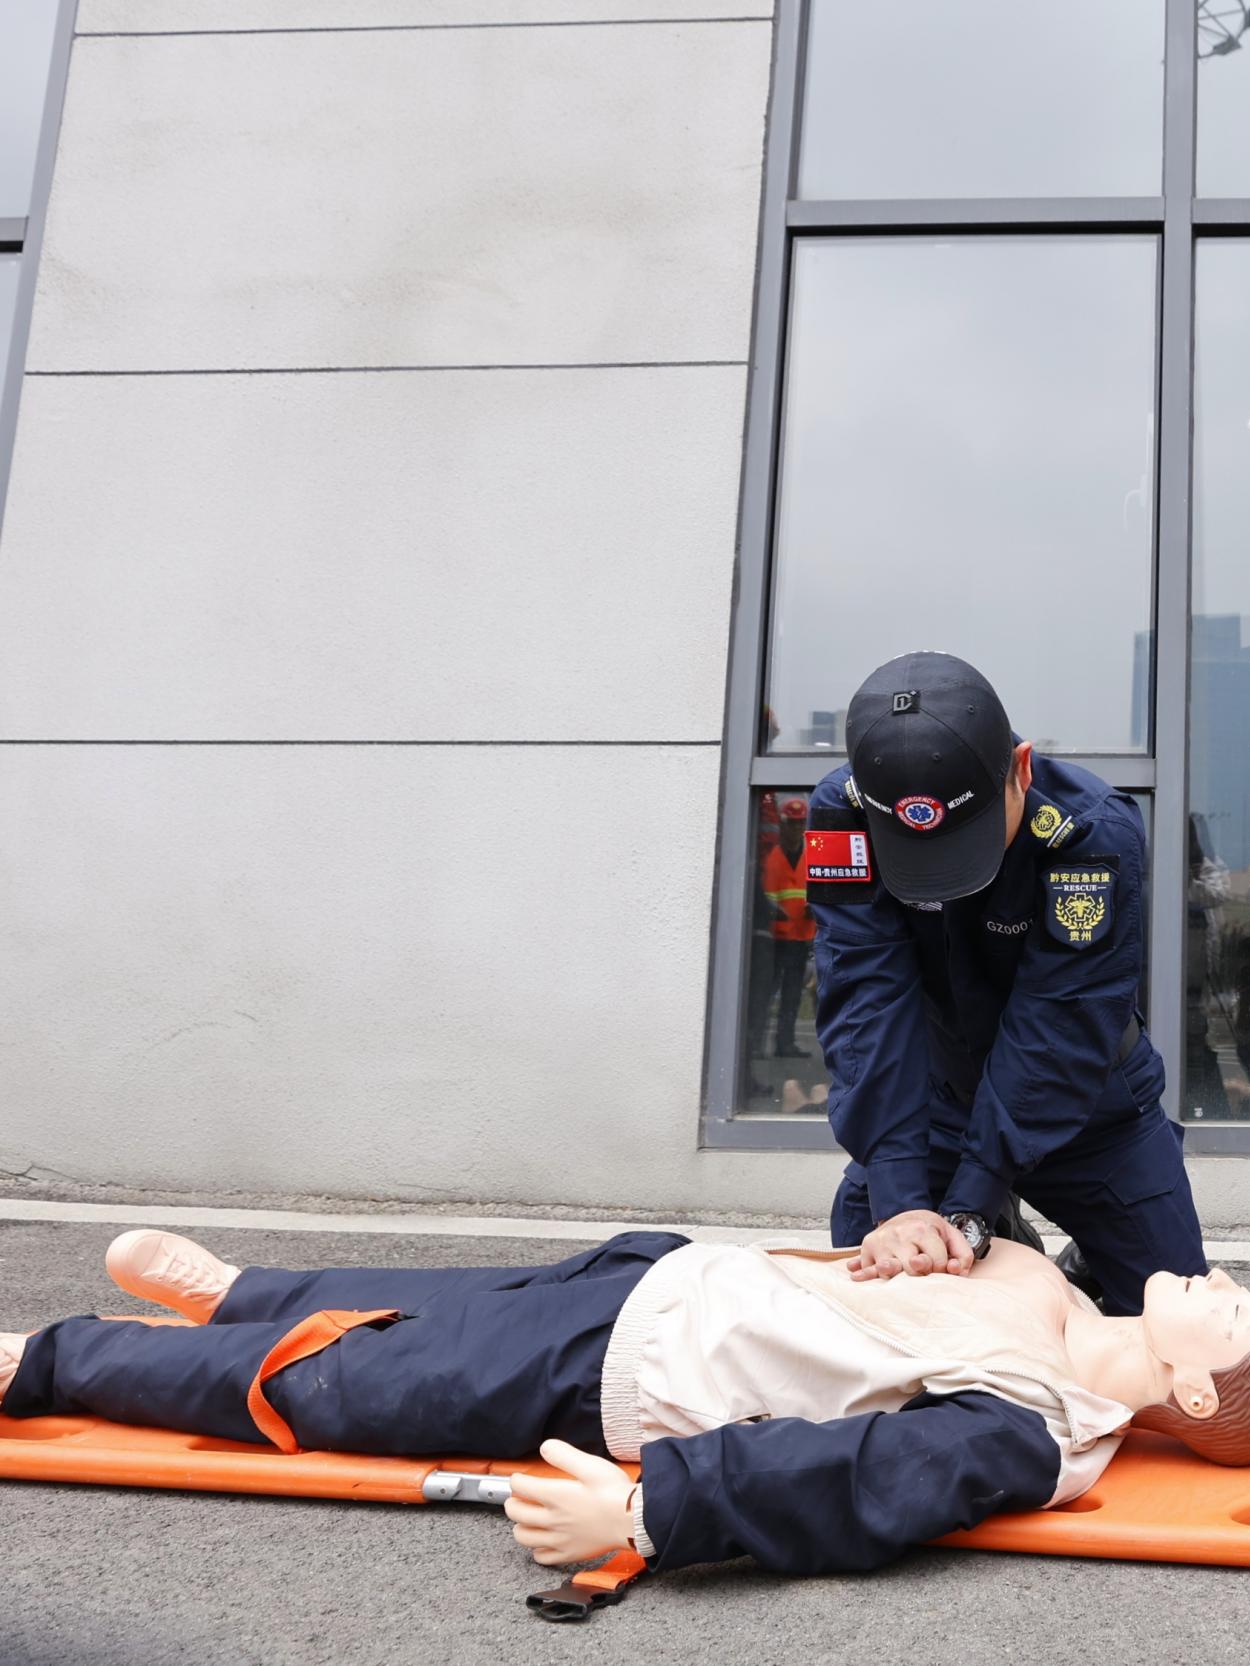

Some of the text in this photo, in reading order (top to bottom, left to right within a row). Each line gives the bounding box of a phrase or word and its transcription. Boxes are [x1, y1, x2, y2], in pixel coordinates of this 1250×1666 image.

[947, 790, 975, 810] MEDICAL
[1063, 884, 1098, 892] RESCUE
[986, 918, 1034, 935] GZ000
[1069, 930, 1092, 942] 贵州
